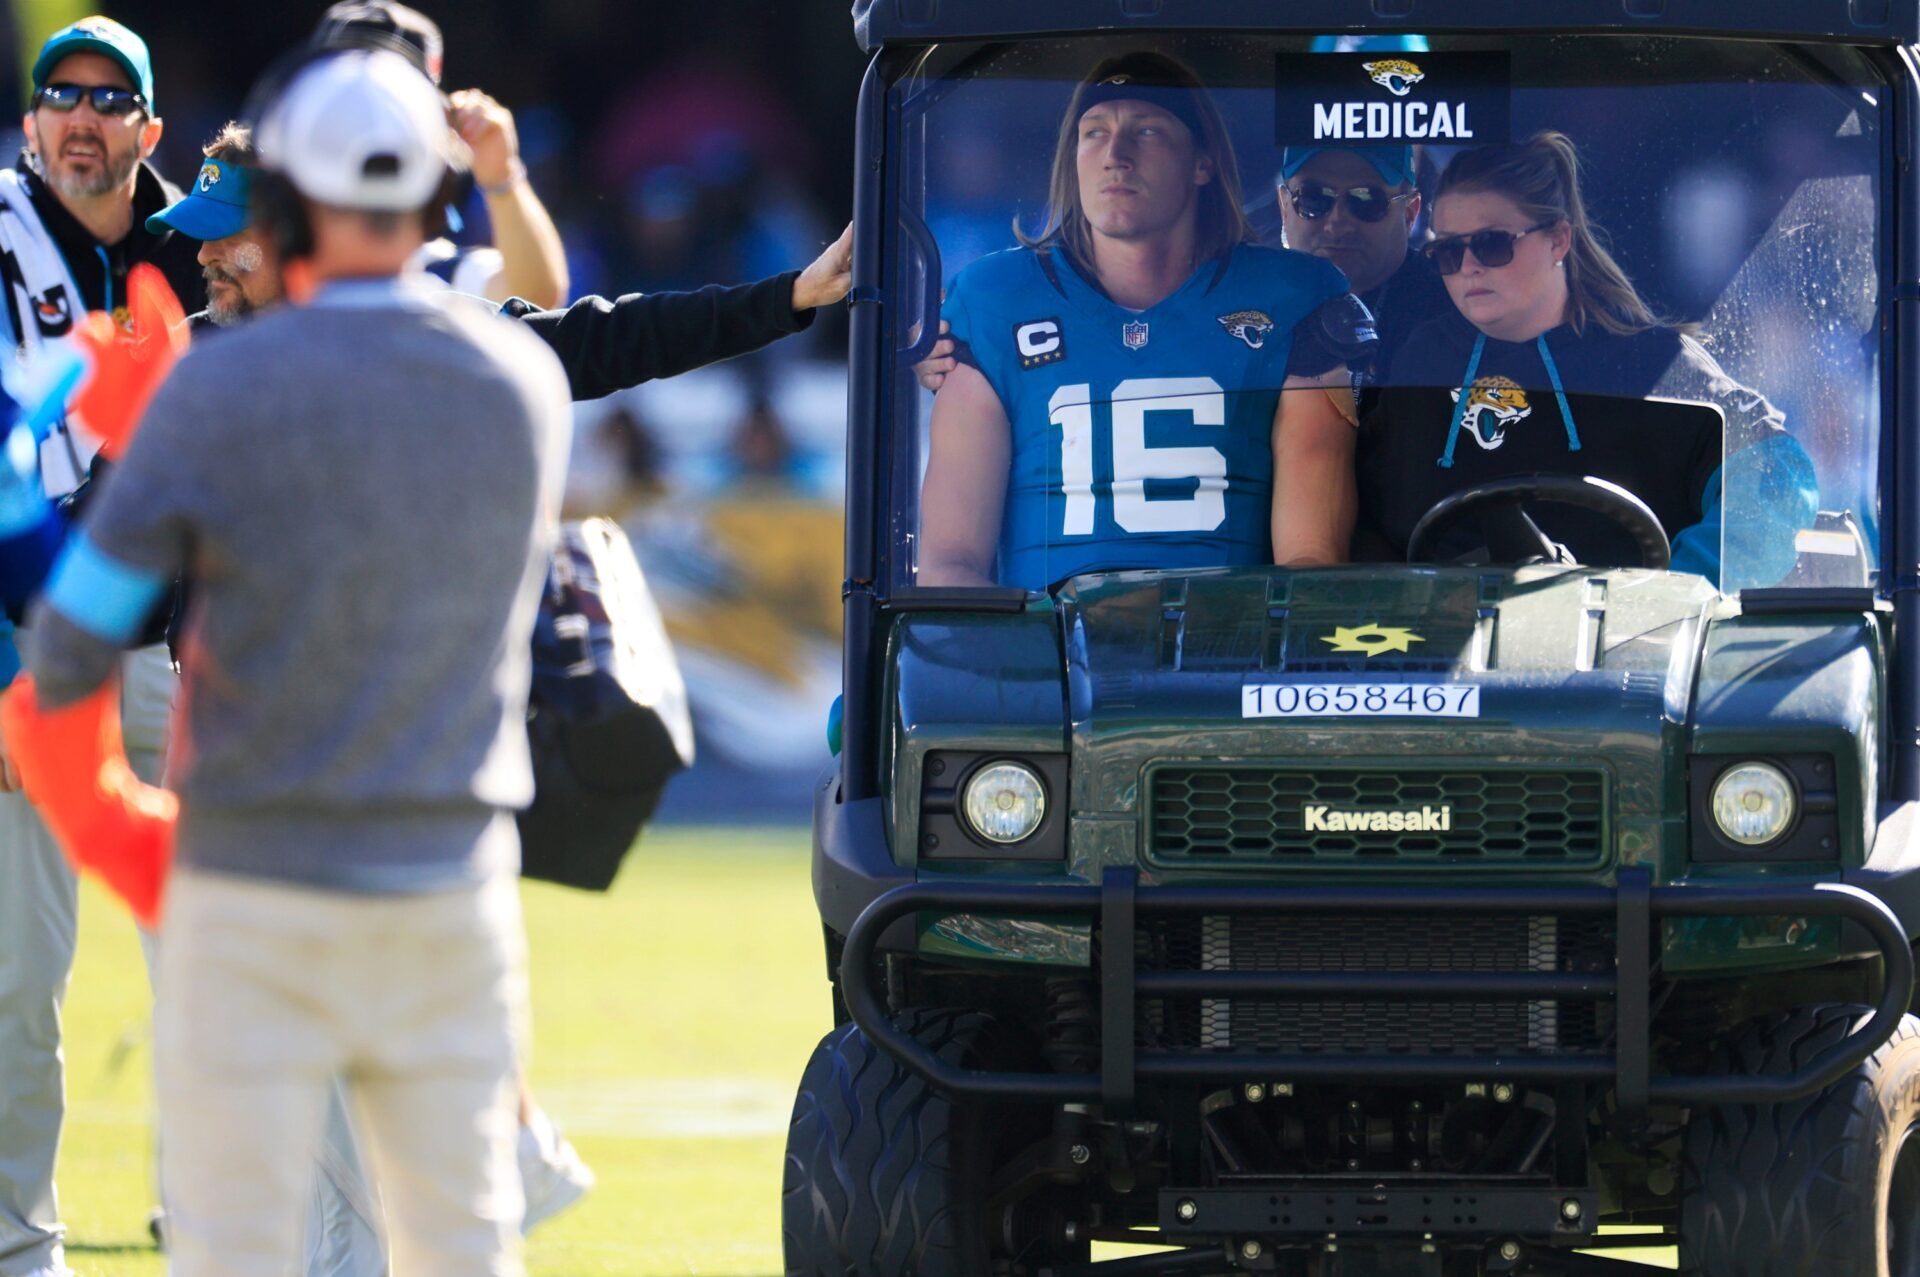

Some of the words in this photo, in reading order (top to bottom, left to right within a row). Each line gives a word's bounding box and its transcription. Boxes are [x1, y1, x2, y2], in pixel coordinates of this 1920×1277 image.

[1313, 102, 1473, 138] MEDICAL
[1017, 321, 1060, 357] C
[1126, 333, 1146, 345] NFL
[1048, 377, 1229, 535] 16
[1248, 686, 1476, 713] 10658467
[1304, 806, 1451, 831] Kawasaki
